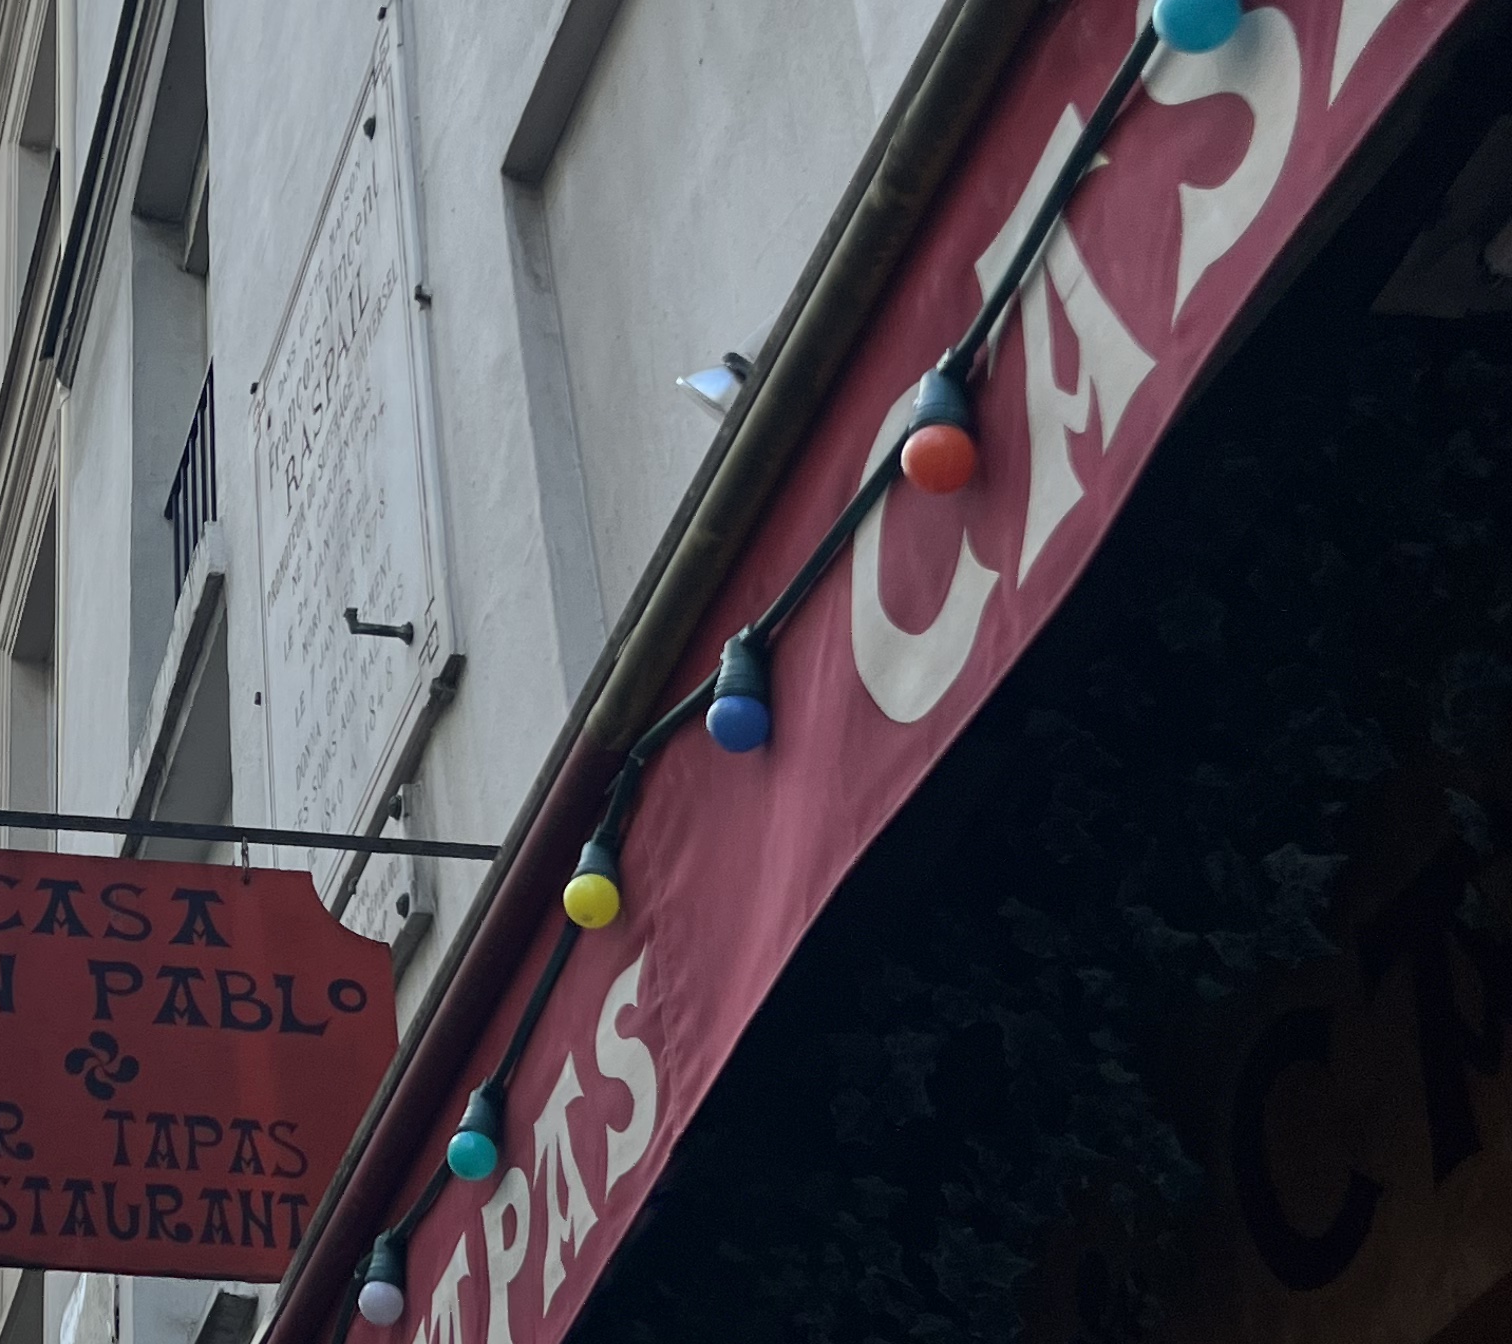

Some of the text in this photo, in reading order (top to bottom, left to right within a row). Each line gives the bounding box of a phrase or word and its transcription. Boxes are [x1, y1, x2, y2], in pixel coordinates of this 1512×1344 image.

[285, 267, 368, 514] RASPAIL
[88, 959, 368, 1036] PABLO
[102, 1109, 309, 1178] TAPAS
